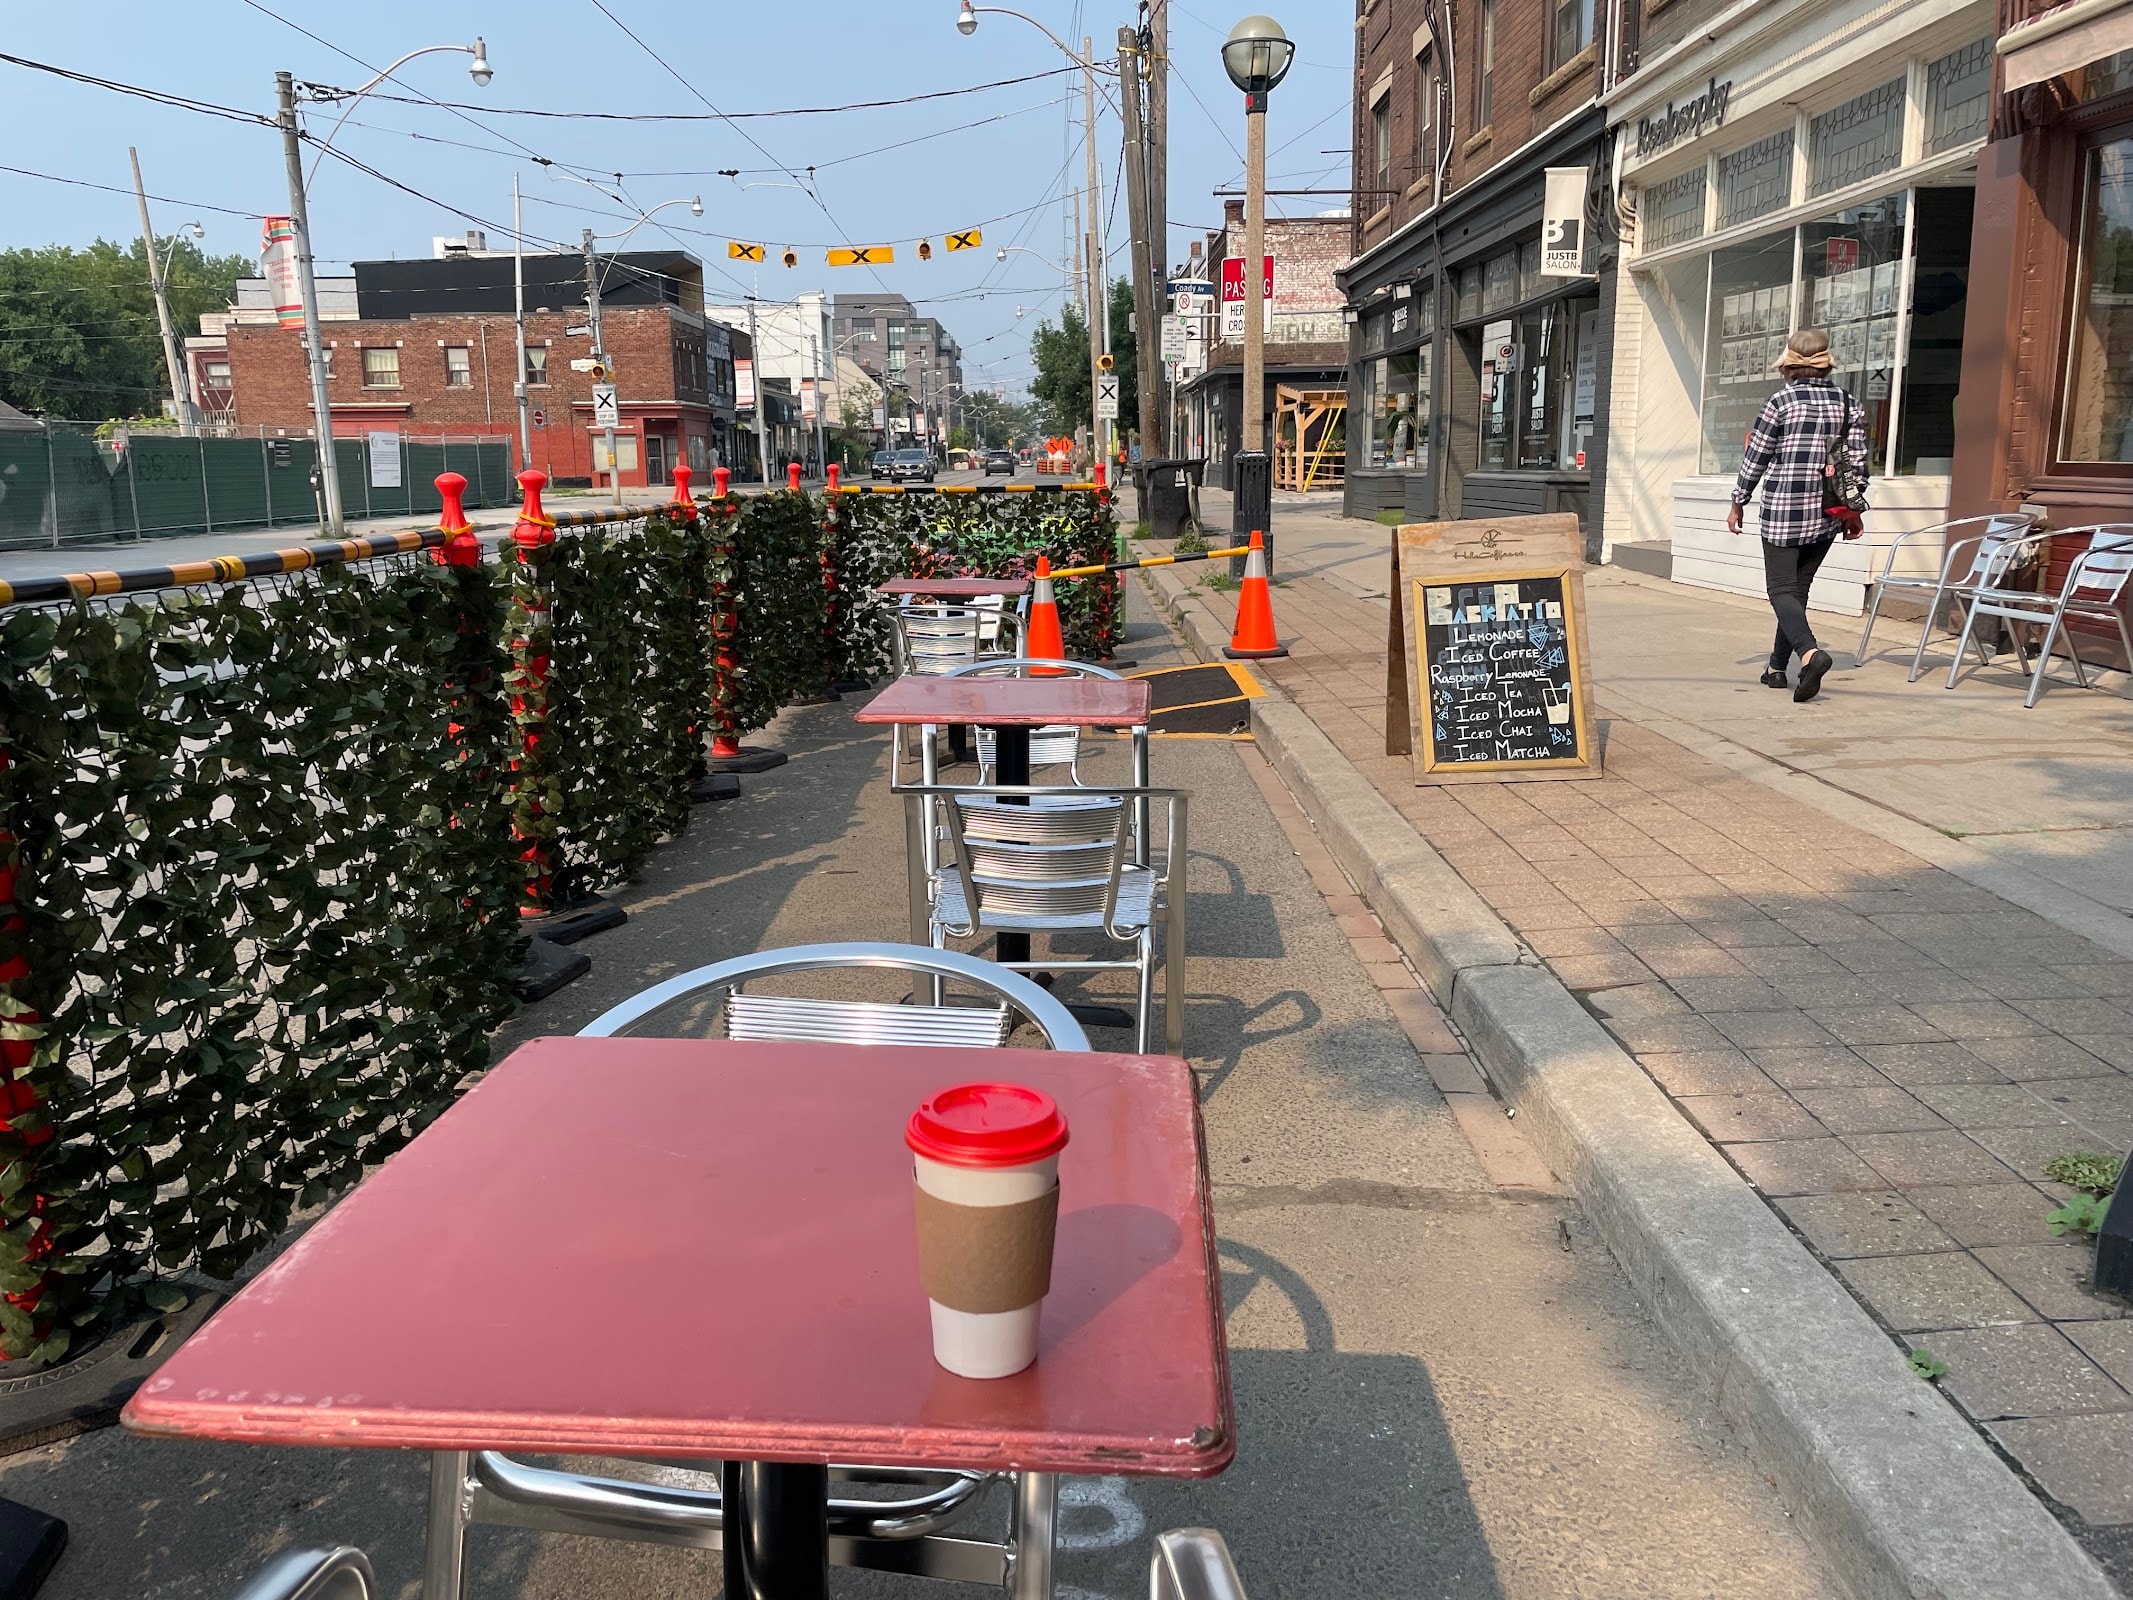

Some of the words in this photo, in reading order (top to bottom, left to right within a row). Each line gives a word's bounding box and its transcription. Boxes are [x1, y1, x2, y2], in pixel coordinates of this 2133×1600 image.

[1635, 77, 1732, 158] Realosophy
[1547, 252, 1577, 260] JUSTB
[1174, 284, 1197, 294] Coady
[1453, 627, 1525, 643] LEMONADE
[1445, 646, 1484, 663] ICED
[1489, 641, 1540, 661] COFFEE
[1430, 664, 1493, 689] Raspberry
[1459, 687, 1497, 703] ICED
[1497, 681, 1523, 699] TEA
[1454, 705, 1490, 722] ICED
[1498, 700, 1543, 719] MOCHA
[1456, 725, 1492, 740] ICED
[1500, 720, 1534, 738] CHAI
[1452, 743, 1489, 761] ICED
[1494, 739, 1551, 761] MATCHA
